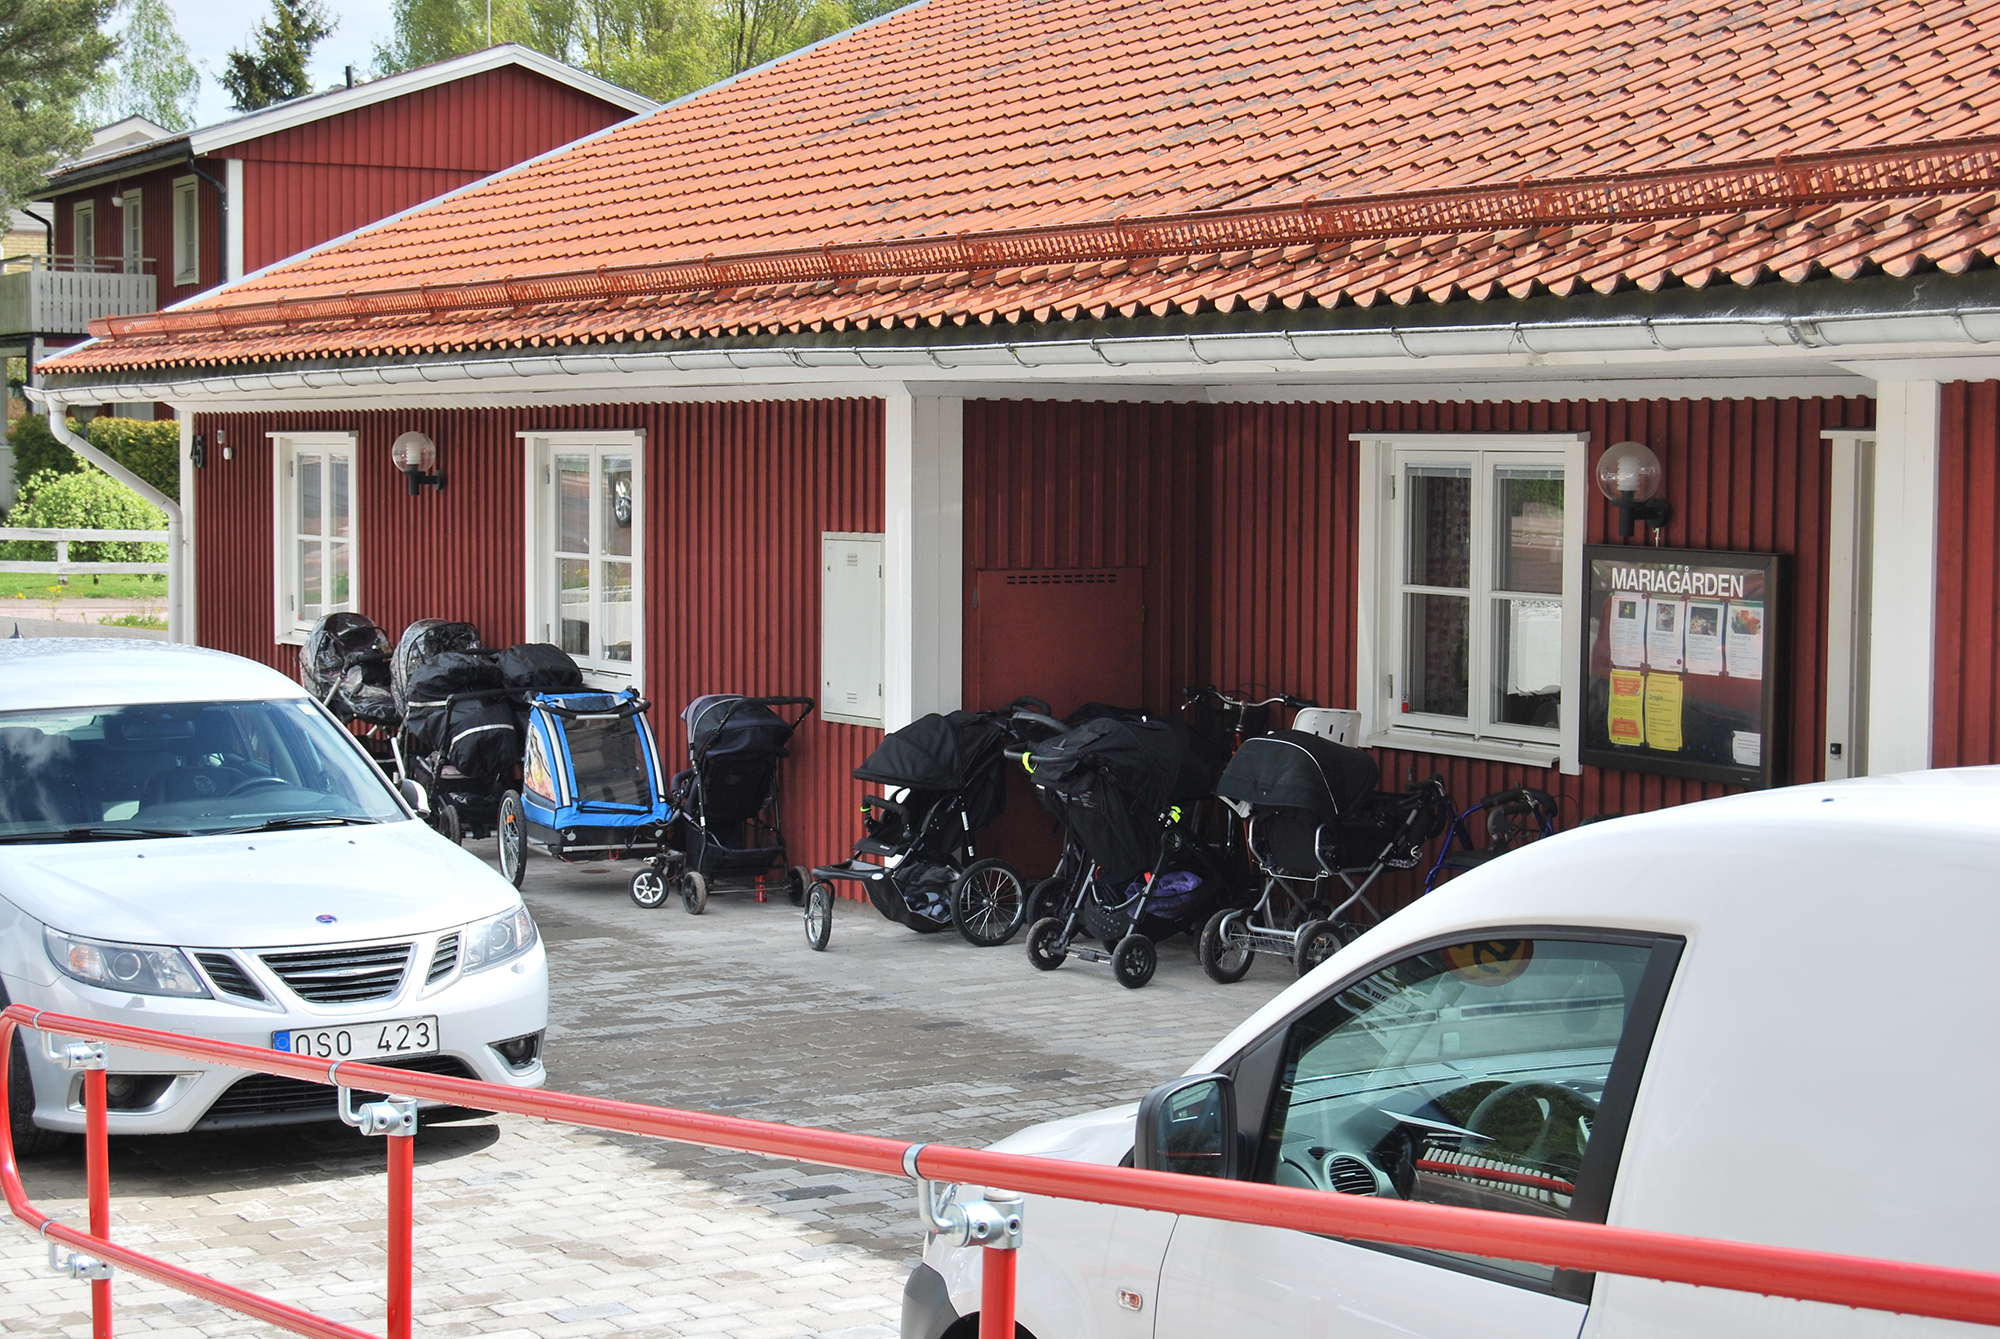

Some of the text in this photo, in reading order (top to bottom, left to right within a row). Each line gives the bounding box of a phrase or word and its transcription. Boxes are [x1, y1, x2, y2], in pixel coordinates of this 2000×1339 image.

[190, 435, 203, 468] 45
[1611, 565, 1744, 598] MARIAGÅRDEN
[296, 1022, 430, 1058] OSO 423
